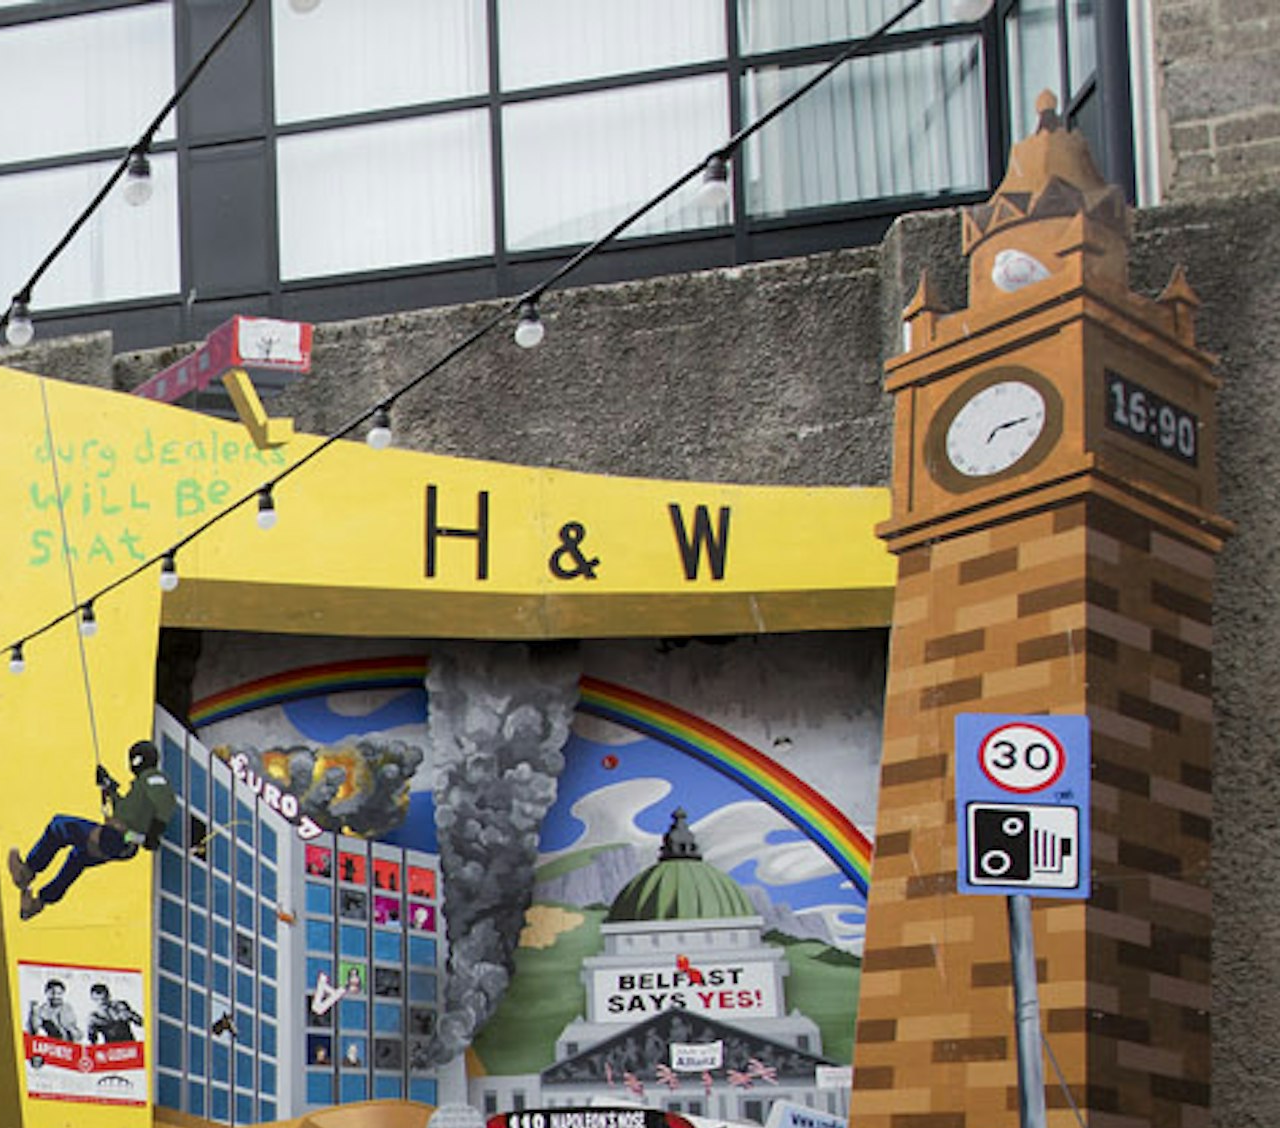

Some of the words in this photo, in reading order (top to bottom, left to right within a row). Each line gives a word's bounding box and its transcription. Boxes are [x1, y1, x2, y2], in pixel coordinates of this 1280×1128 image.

[1110, 382, 1194, 457] 16:90
[424, 484, 489, 580] H
[548, 521, 600, 580] &
[668, 503, 730, 580] W
[992, 740, 1051, 771] 30
[618, 967, 744, 991] BELFAST
[607, 992, 687, 1014] SAYS
[698, 989, 763, 1010] YES!
